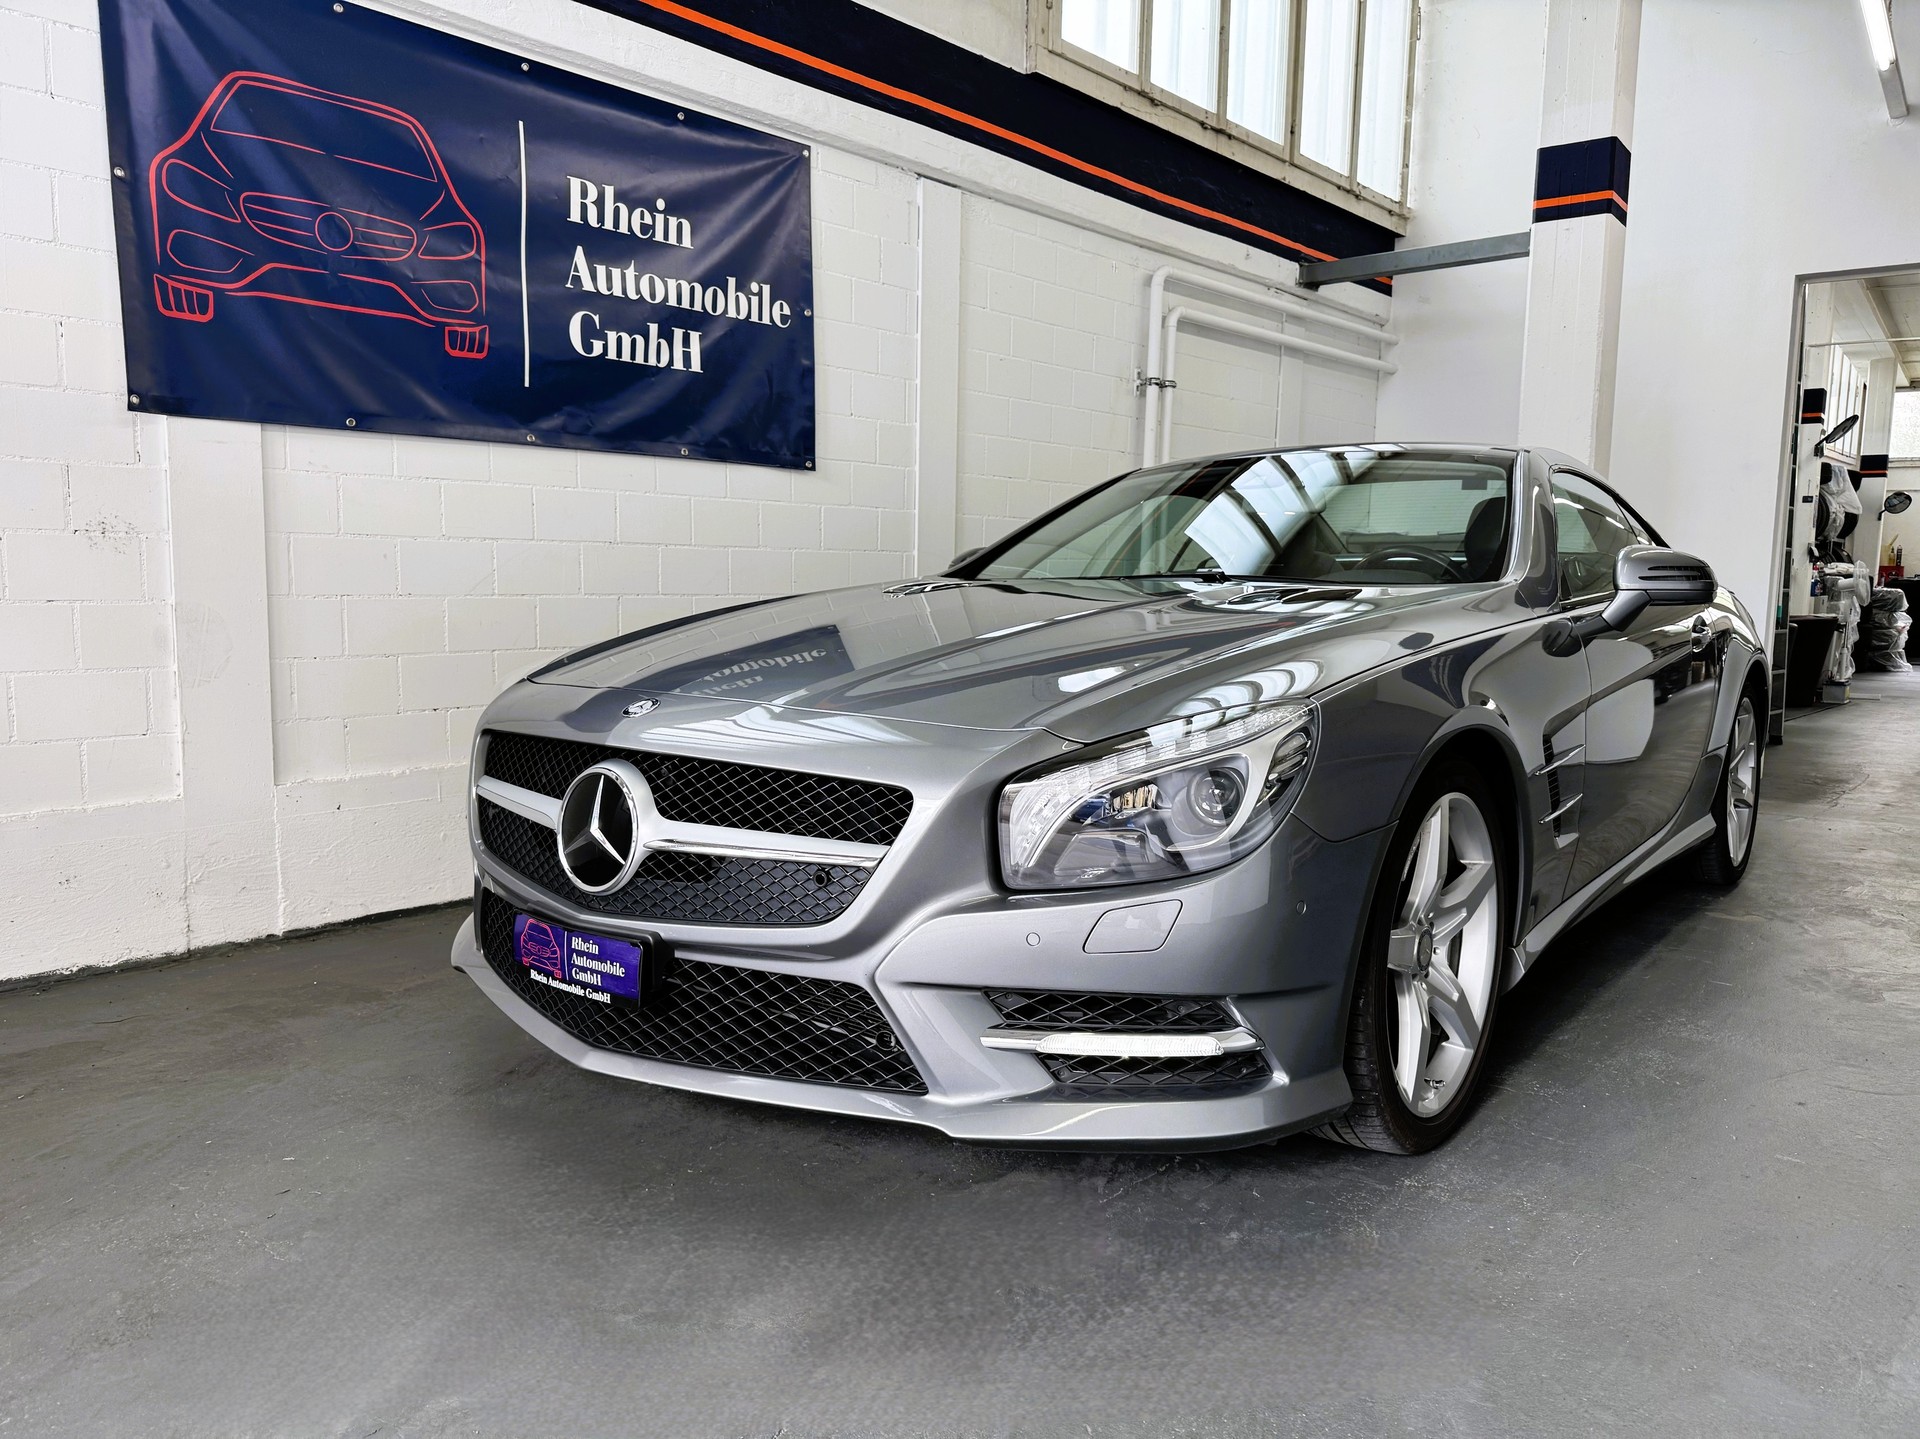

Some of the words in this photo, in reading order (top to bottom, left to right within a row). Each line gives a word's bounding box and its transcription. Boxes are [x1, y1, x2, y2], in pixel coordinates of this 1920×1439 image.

[566, 175, 694, 249] Rhein
[565, 245, 791, 328] Automobile
[568, 310, 704, 373] GmbH
[571, 936, 599, 955] Rhein
[571, 952, 626, 977] Automobile
[572, 967, 602, 986] GmbH
[530, 968, 548, 984] Rhein
[547, 977, 585, 997] Automobile
[585, 989, 611, 1004] GmbH
